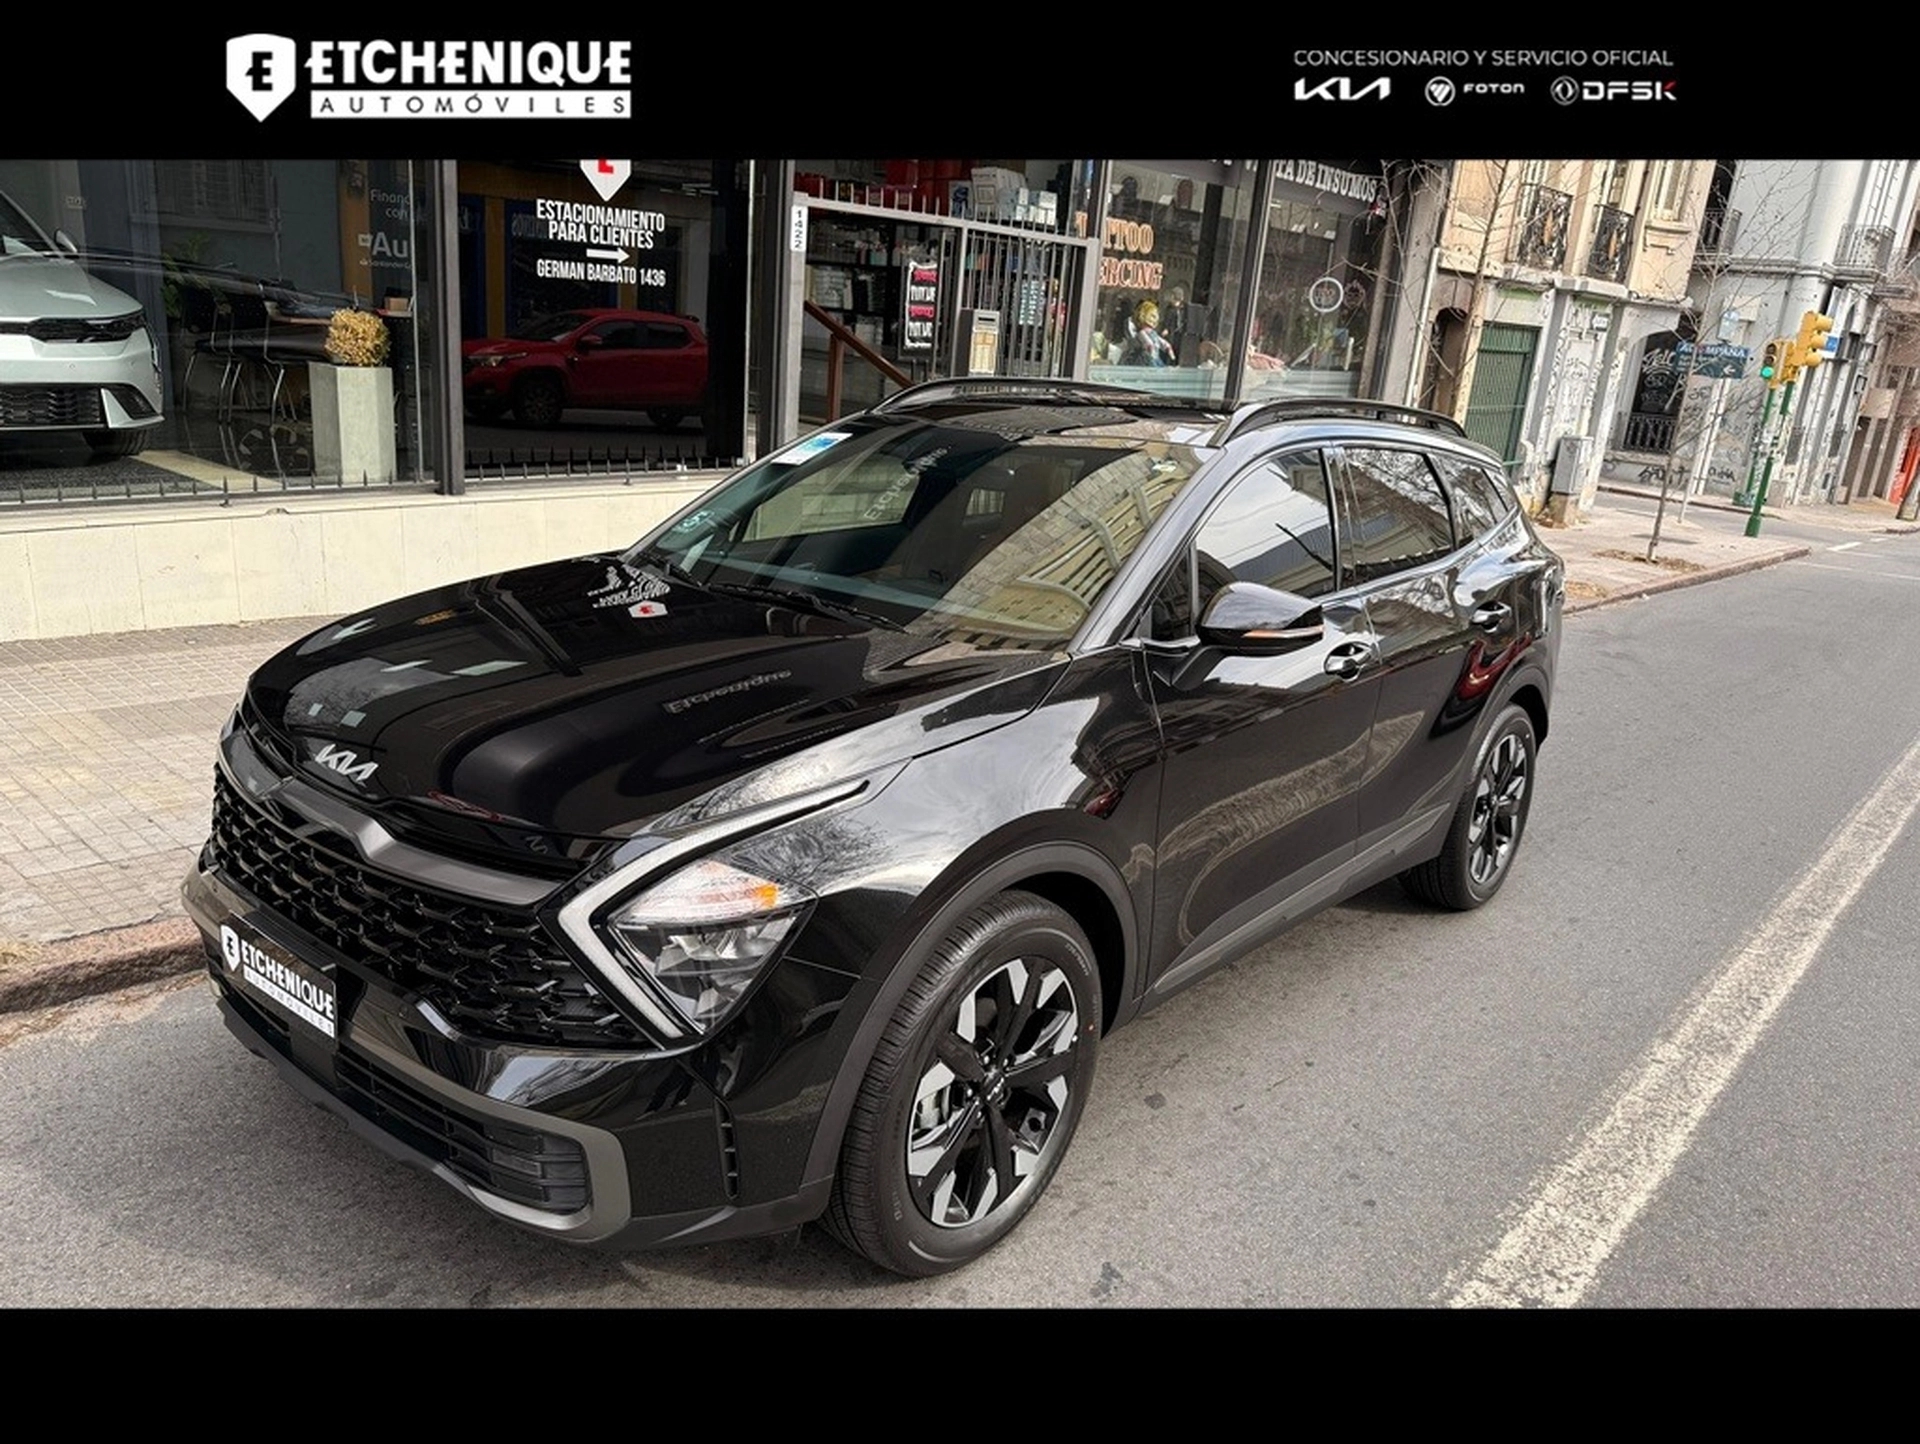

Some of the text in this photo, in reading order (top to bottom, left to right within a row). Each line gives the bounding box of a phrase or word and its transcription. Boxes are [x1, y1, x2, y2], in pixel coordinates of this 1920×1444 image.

[1295, 160, 1317, 187] DE
[1315, 163, 1377, 203] INSUMOS
[536, 199, 665, 233] ESTACIONAMIENTO
[548, 220, 588, 243] PARA
[590, 224, 655, 249] CLIENTES
[536, 259, 667, 287] GERMAN BARBATO 1436
[1098, 256, 1164, 291] ERCING
[241, 939, 335, 1020] ETCHENIQUE
